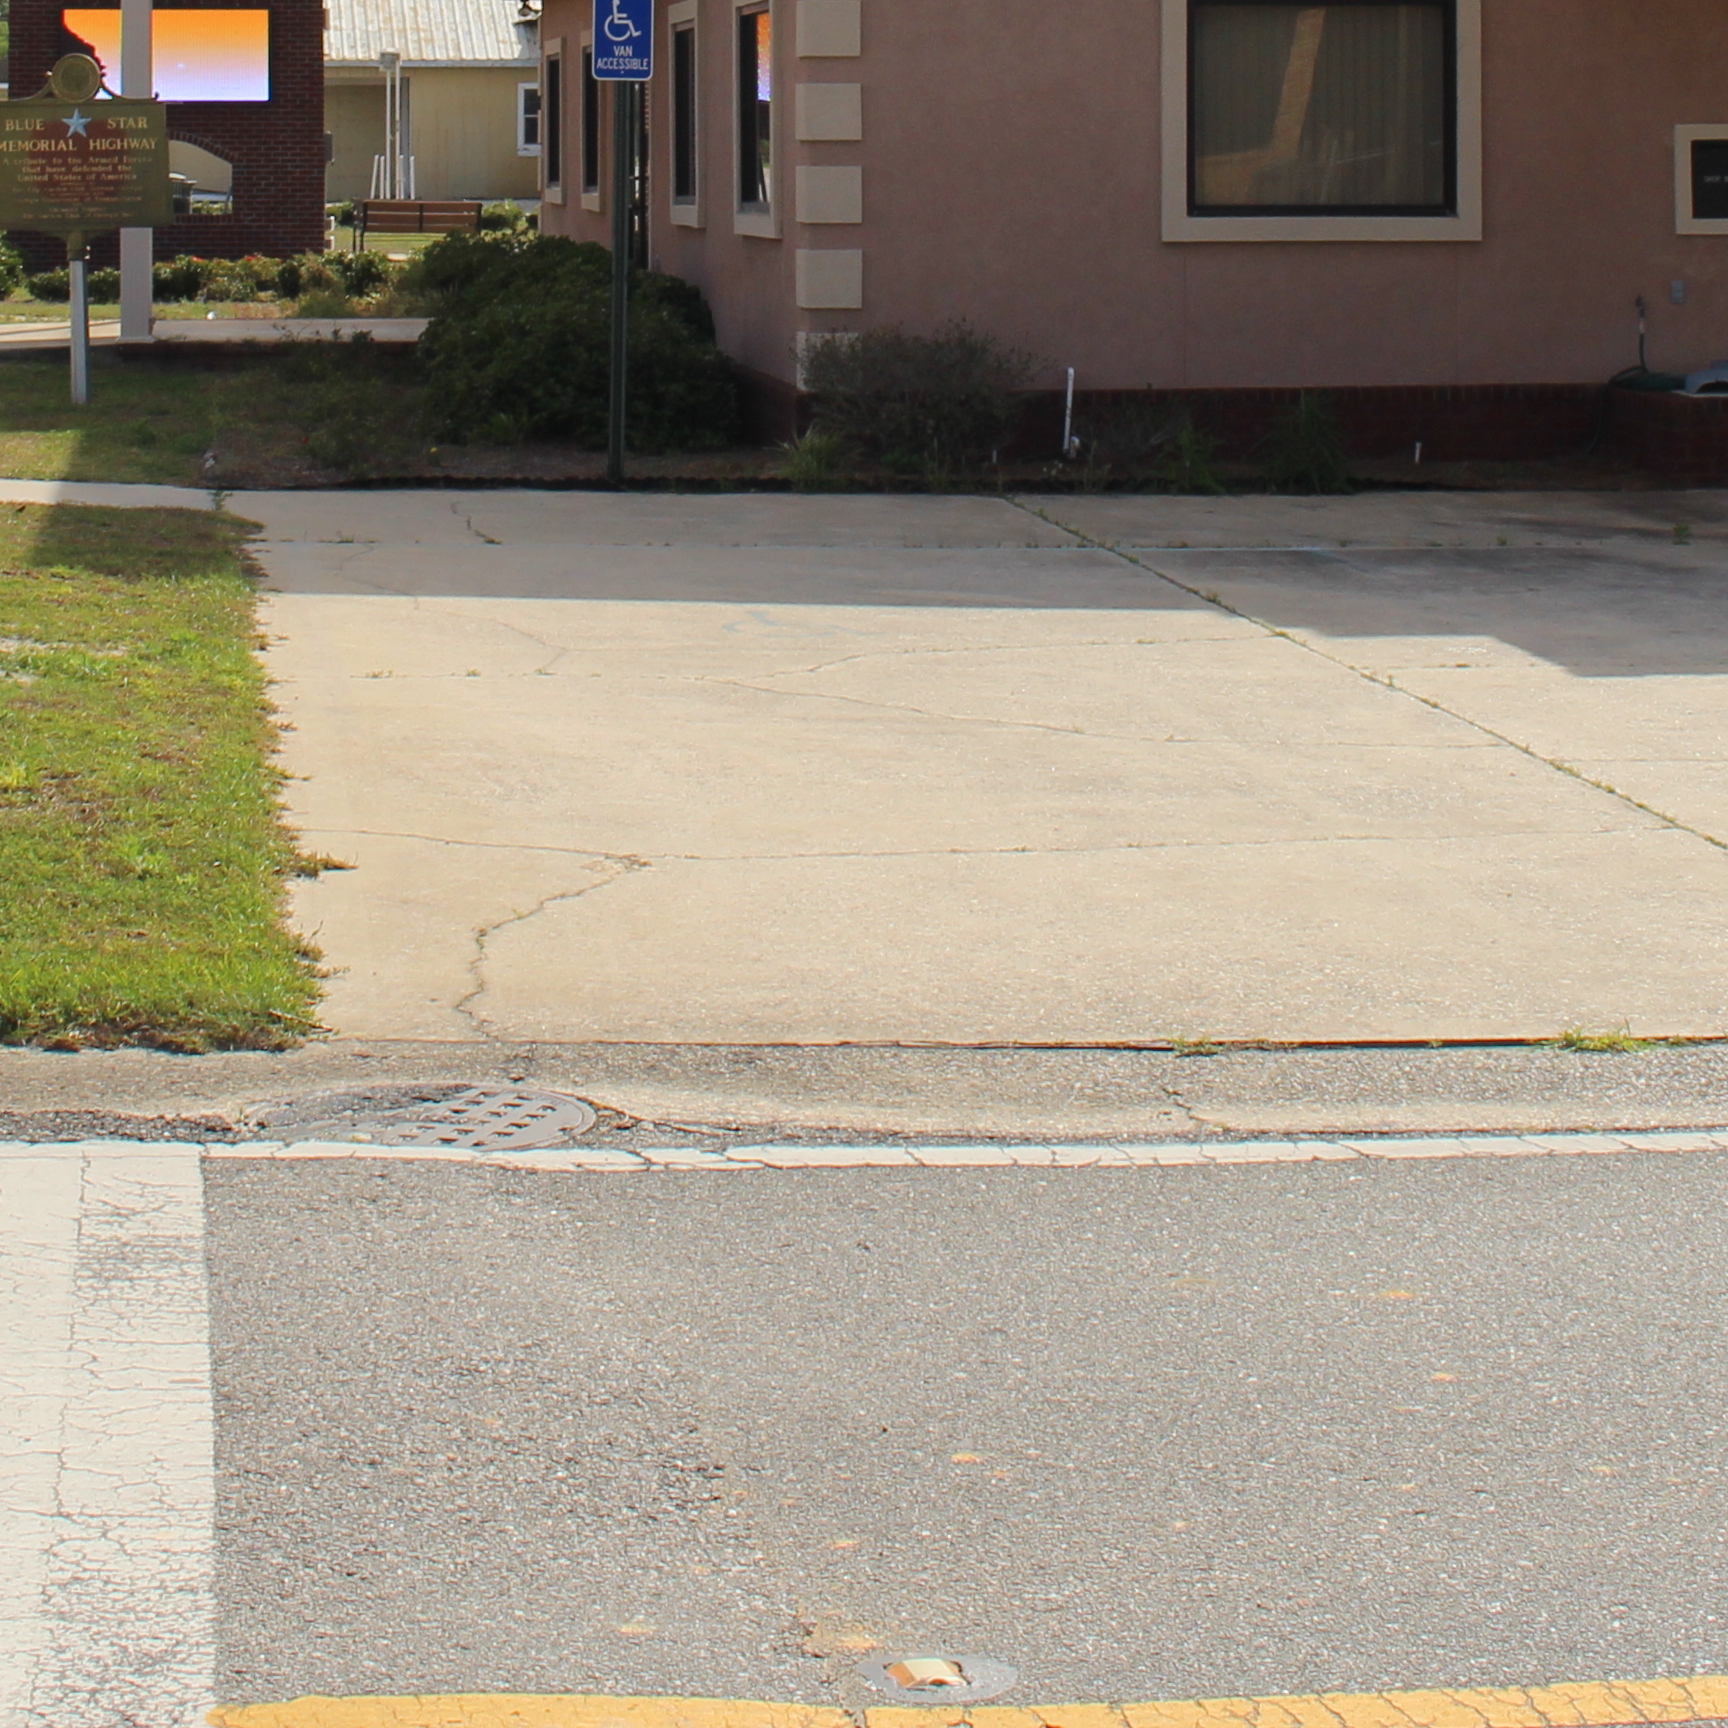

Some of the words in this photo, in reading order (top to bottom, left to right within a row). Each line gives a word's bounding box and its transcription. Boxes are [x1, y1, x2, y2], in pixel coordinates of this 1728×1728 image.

[613, 45, 633, 57] VAN
[596, 57, 649, 70] ACCESSIBLE
[4, 118, 45, 131] BLUE
[107, 116, 148, 130] STAR
[89, 137, 159, 151] HIGHWAY
[53, 157, 62, 165] to
